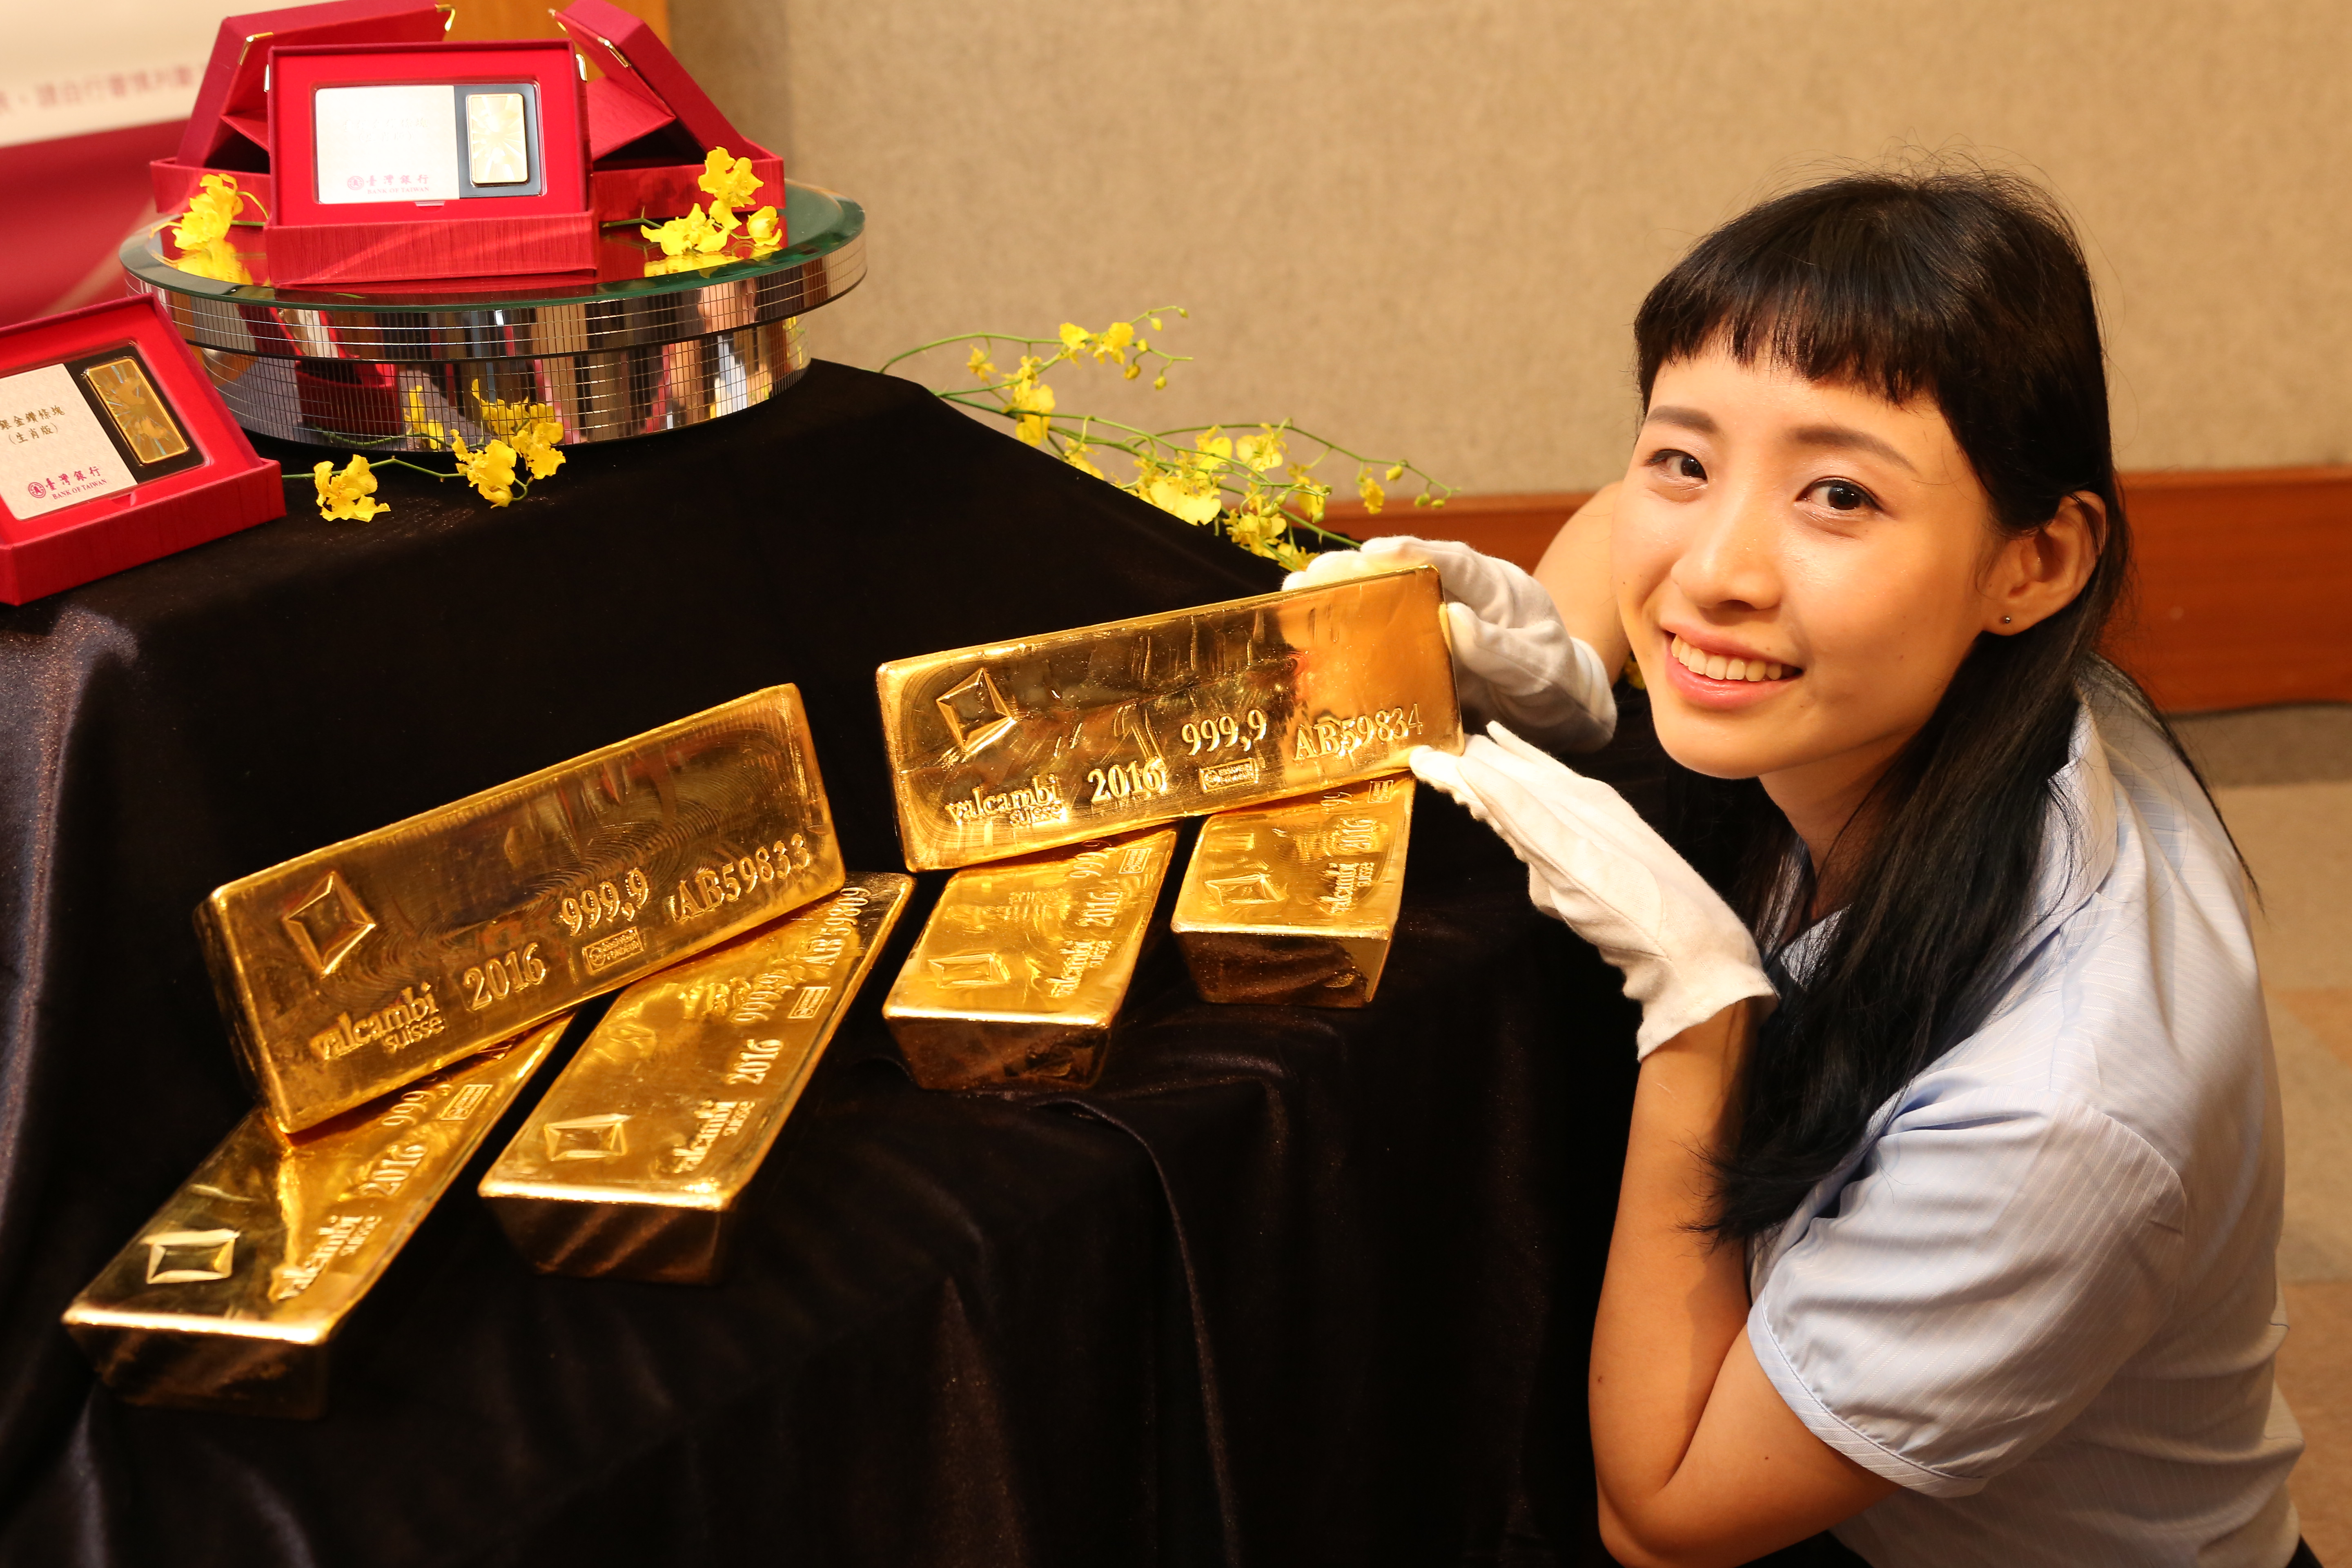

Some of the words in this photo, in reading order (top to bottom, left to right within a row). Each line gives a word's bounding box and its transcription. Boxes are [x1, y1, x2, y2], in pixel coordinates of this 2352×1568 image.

[46, 466, 101, 491] 臺灣銀行
[52, 490, 72, 500] BANK
[81, 479, 107, 491] TAIWAN
[1182, 709, 1267, 755] 999,9
[1293, 703, 1423, 761] AB59834
[945, 774, 1062, 825] valcambi
[1088, 756, 1165, 803] 2016
[1338, 818, 1378, 851] 2016
[676, 833, 811, 924] AB59833
[559, 868, 649, 937] 999,9
[1075, 892, 1123, 927] 2016
[800, 887, 871, 966] AB59809
[464, 942, 547, 1013] 2016
[735, 974, 795, 1021] 999,9
[310, 982, 440, 1061] valcambi
[383, 1016, 445, 1053] suisse
[727, 1039, 783, 1085] 2016
[359, 1145, 427, 1196] 2016
